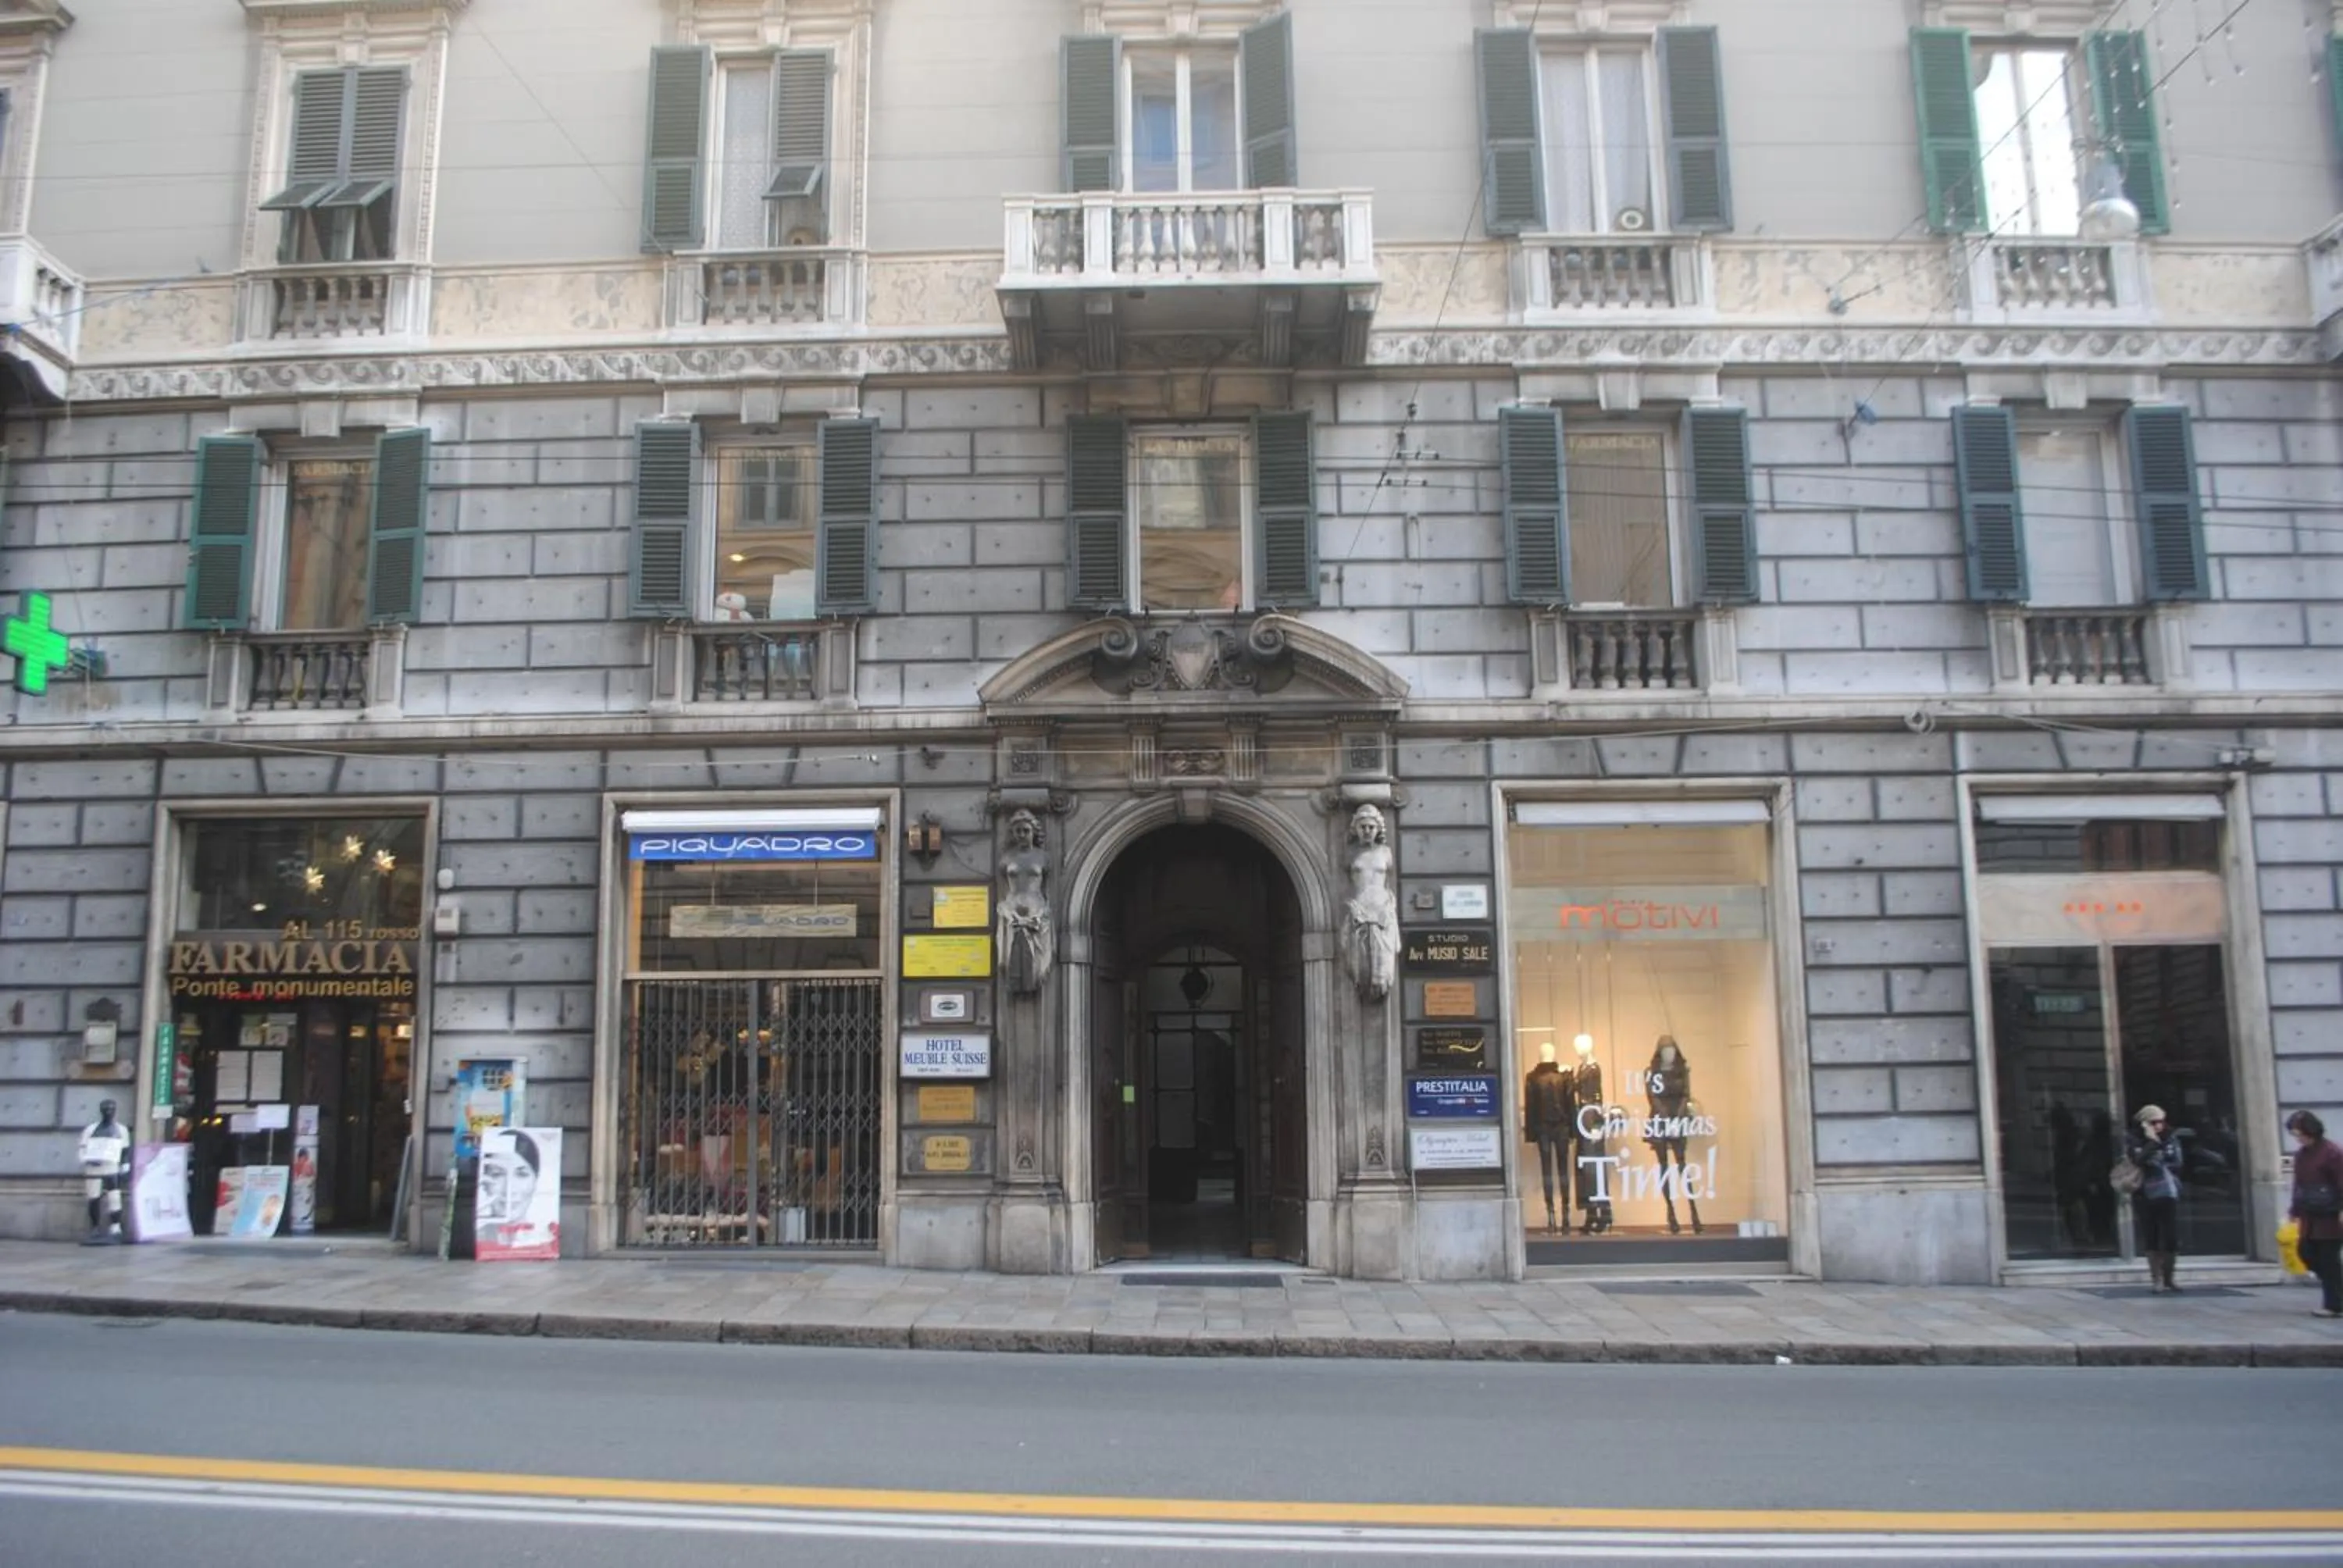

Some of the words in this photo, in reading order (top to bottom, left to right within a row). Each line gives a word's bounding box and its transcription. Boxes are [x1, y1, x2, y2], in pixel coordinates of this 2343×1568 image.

[640, 836, 865, 856] PIQUADRO
[282, 920, 314, 939] AL
[324, 919, 362, 939] 115
[368, 927, 419, 940] rosso
[169, 940, 412, 974] FARMACIA
[1462, 946, 1488, 960] SALE
[172, 978, 241, 997] Ponte
[251, 976, 413, 996] monumentale
[925, 1039, 963, 1051] HOTEL
[950, 1052, 987, 1064] SUISSE
[1416, 1081, 1488, 1092] PRESTITALIA
[1576, 1104, 1718, 1140] Christmas
[1577, 1146, 1717, 1202] Time!
